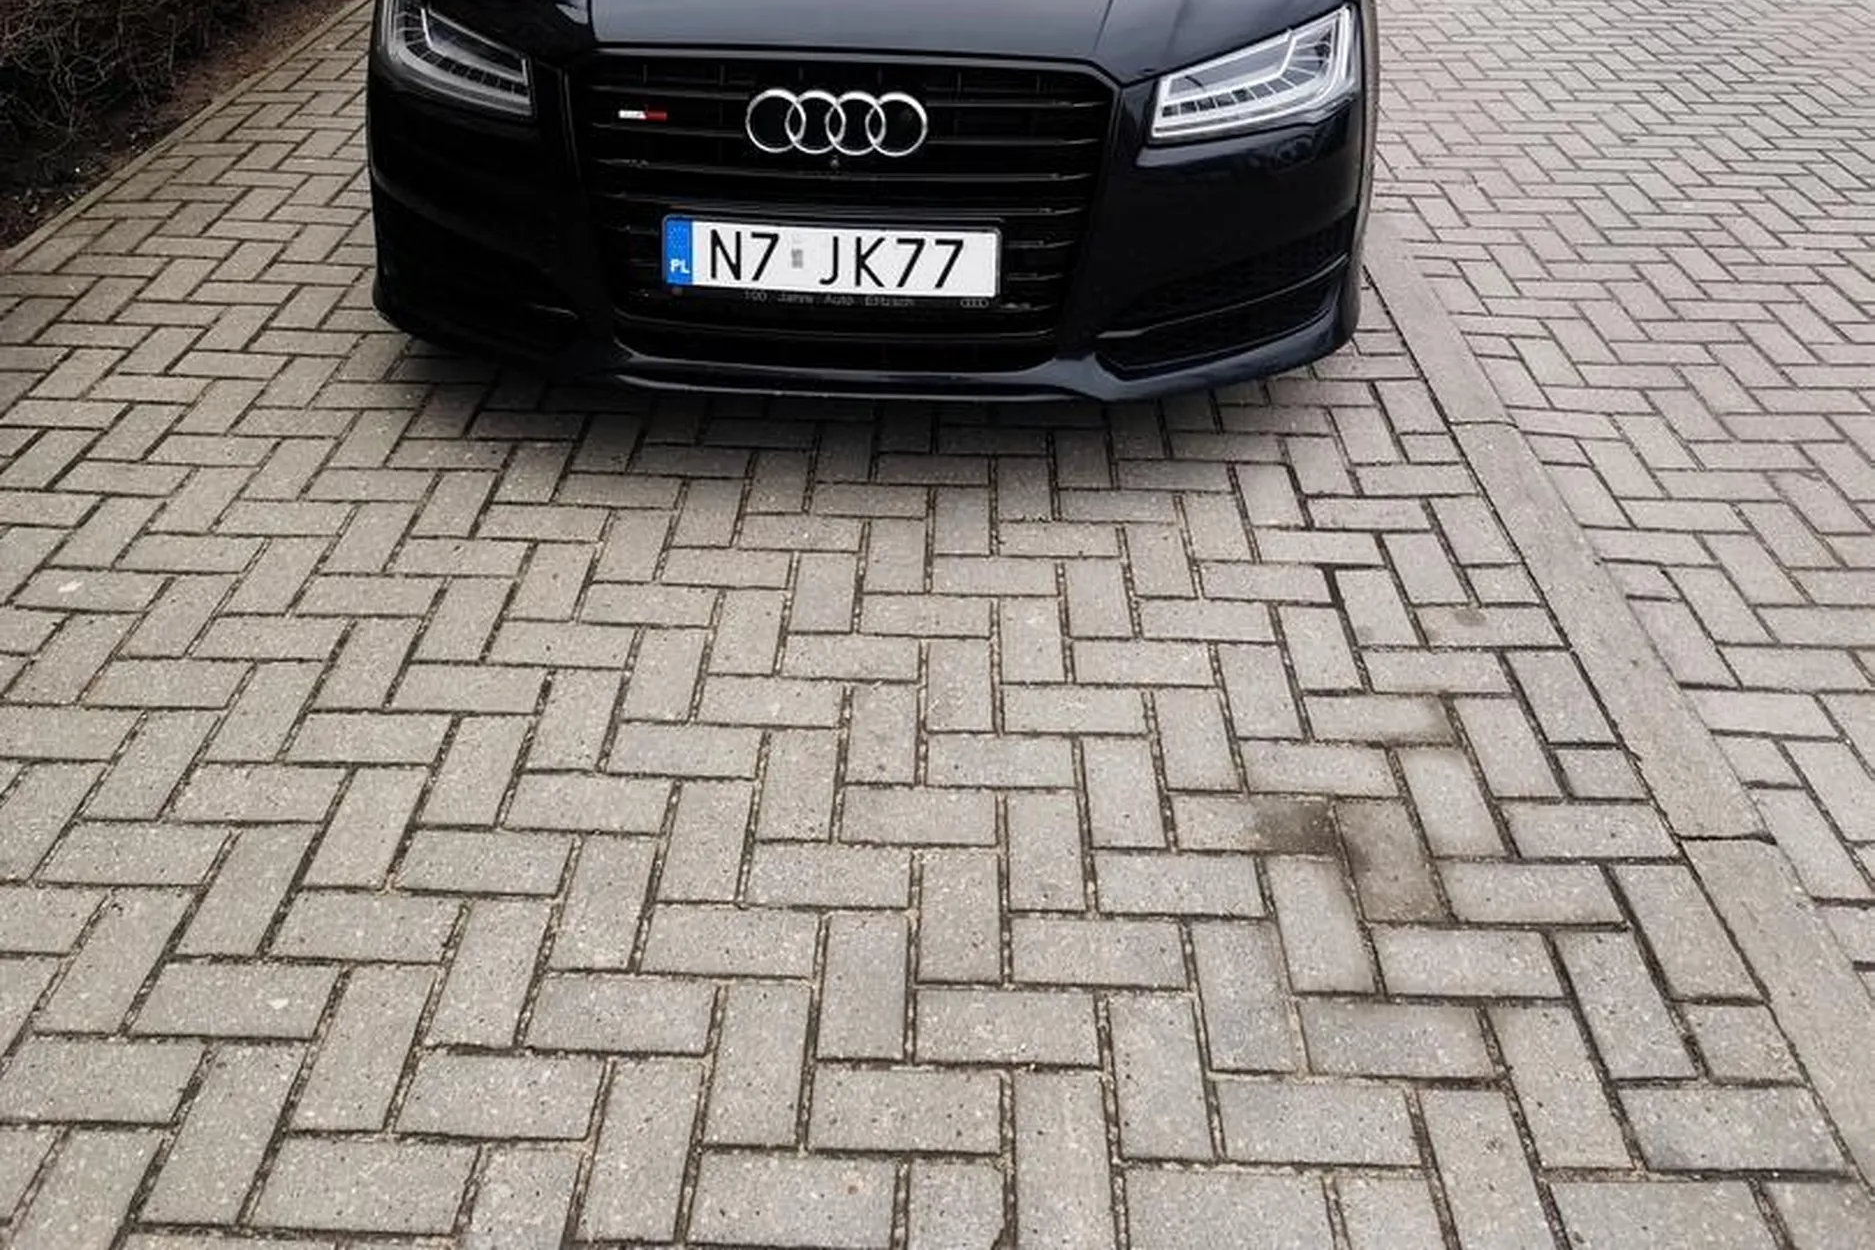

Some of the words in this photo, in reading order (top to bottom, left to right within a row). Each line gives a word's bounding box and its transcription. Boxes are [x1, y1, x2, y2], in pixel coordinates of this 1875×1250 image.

[670, 258, 690, 274] PL
[709, 229, 780, 282] N7
[819, 236, 964, 289] JK77
[742, 289, 768, 301] 100
